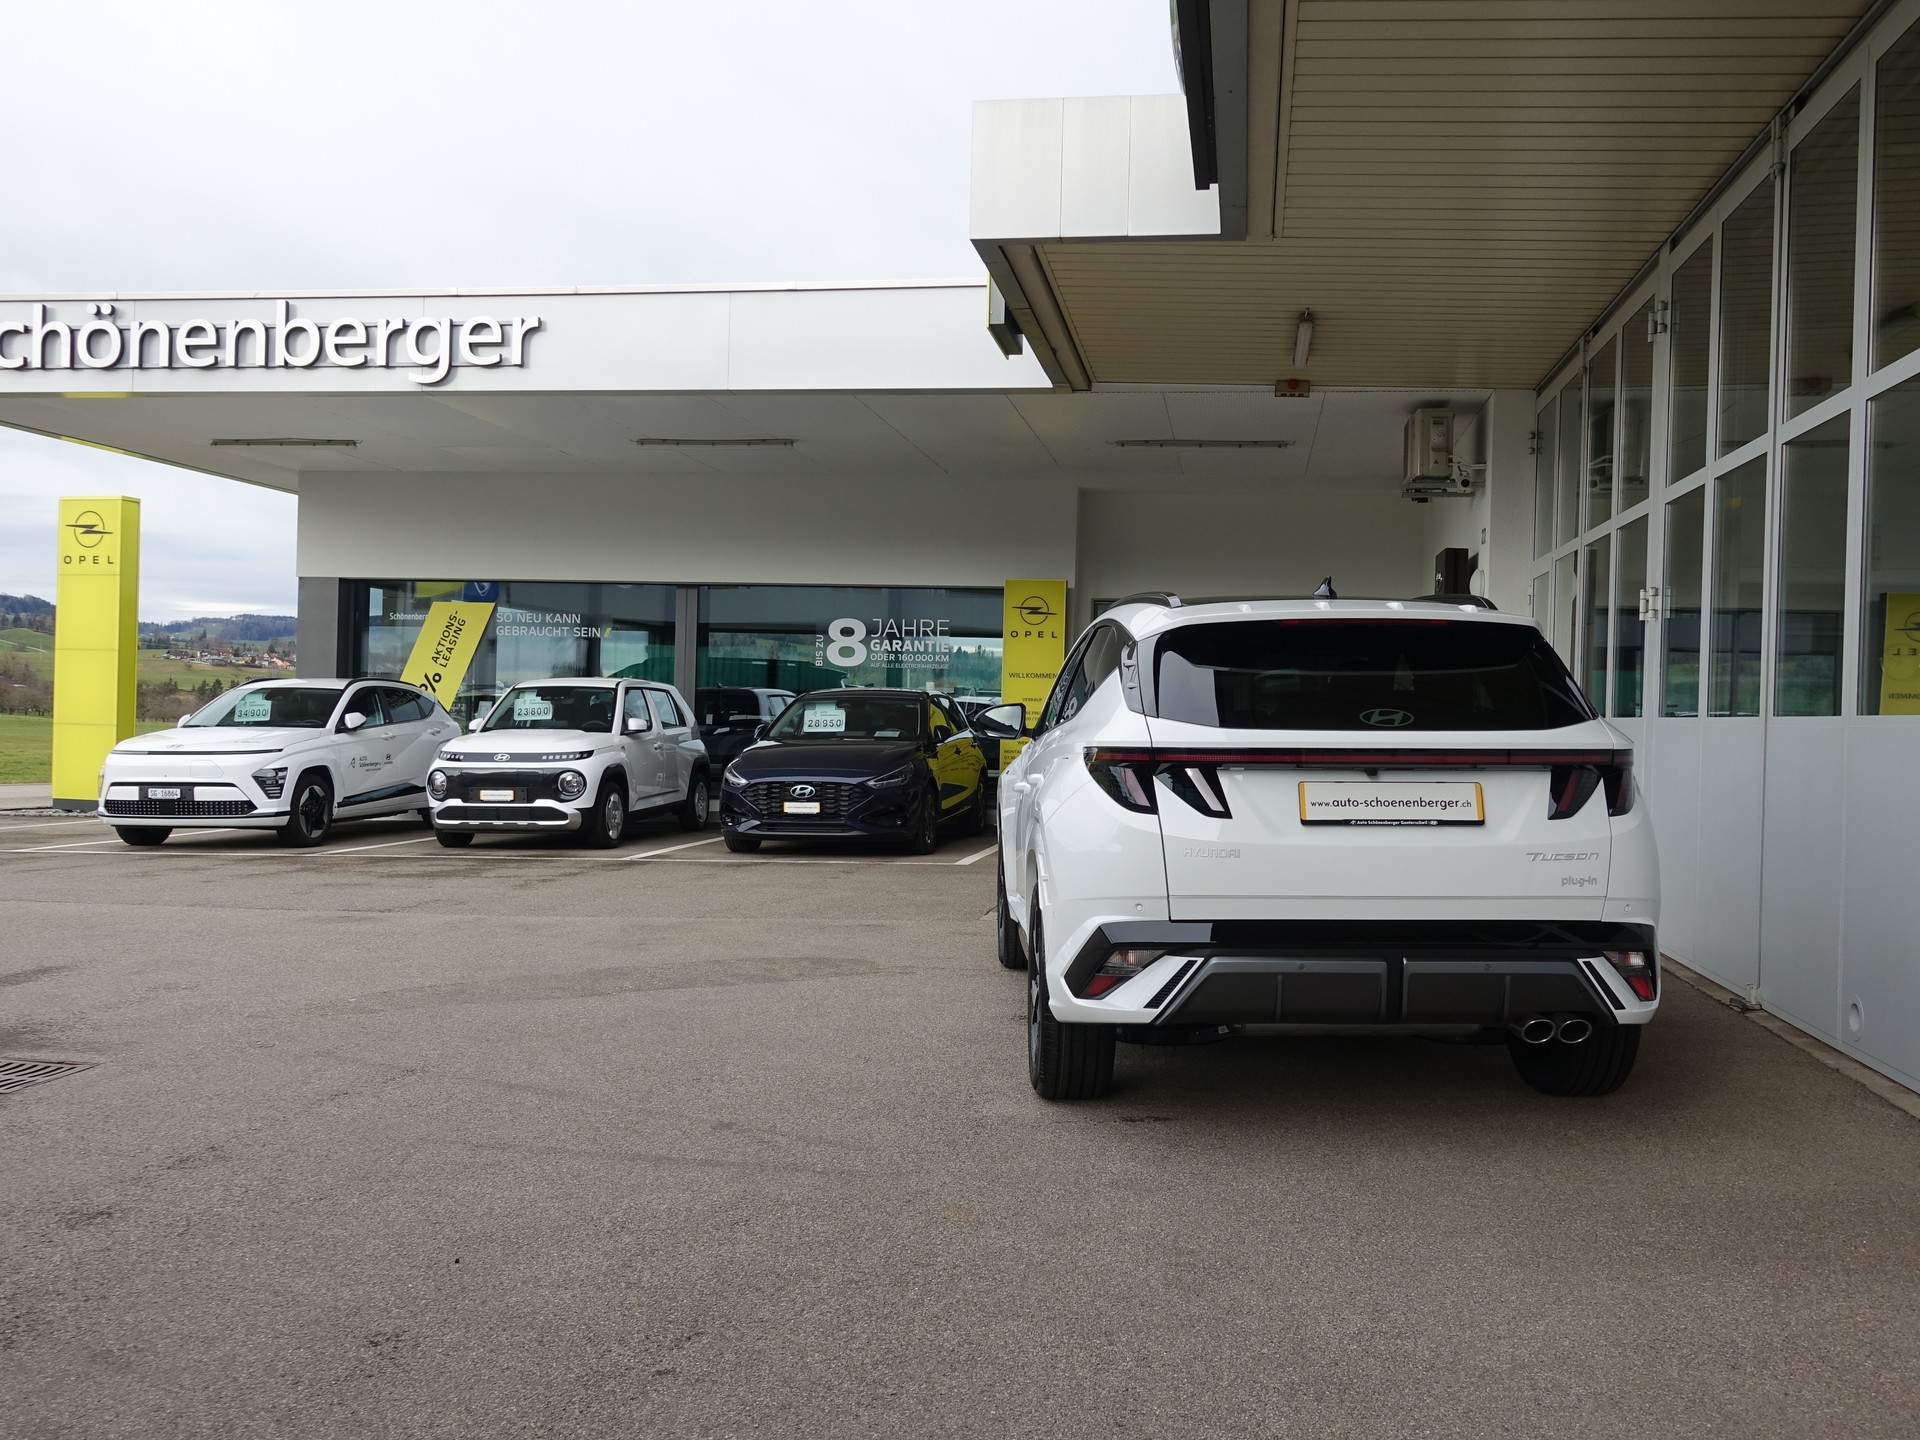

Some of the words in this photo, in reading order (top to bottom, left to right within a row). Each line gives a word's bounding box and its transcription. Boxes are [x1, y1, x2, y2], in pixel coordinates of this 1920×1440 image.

[63, 555, 114, 564] OPEL
[496, 613, 513, 622] SO
[517, 613, 541, 623] NEU
[546, 613, 581, 623] KANN
[496, 626, 569, 637] GEBRAUCHT
[573, 627, 601, 637] SEIN
[870, 619, 950, 638] JAHRE
[1010, 630, 1057, 638] OPEL
[432, 611, 459, 664] AKTIONS-
[439, 618, 466, 668] LEASING
[815, 634, 824, 648] ZU
[826, 618, 867, 667] 8
[870, 640, 950, 653] GARANTIE
[815, 650, 823, 666] BIS
[870, 653, 895, 661] ODER
[935, 654, 949, 662] KM
[1310, 797, 1472, 810] www.auto-schoenenberger.ch
[1183, 847, 1241, 859] HYUNDAI
[1561, 875, 1598, 887] plug-in
